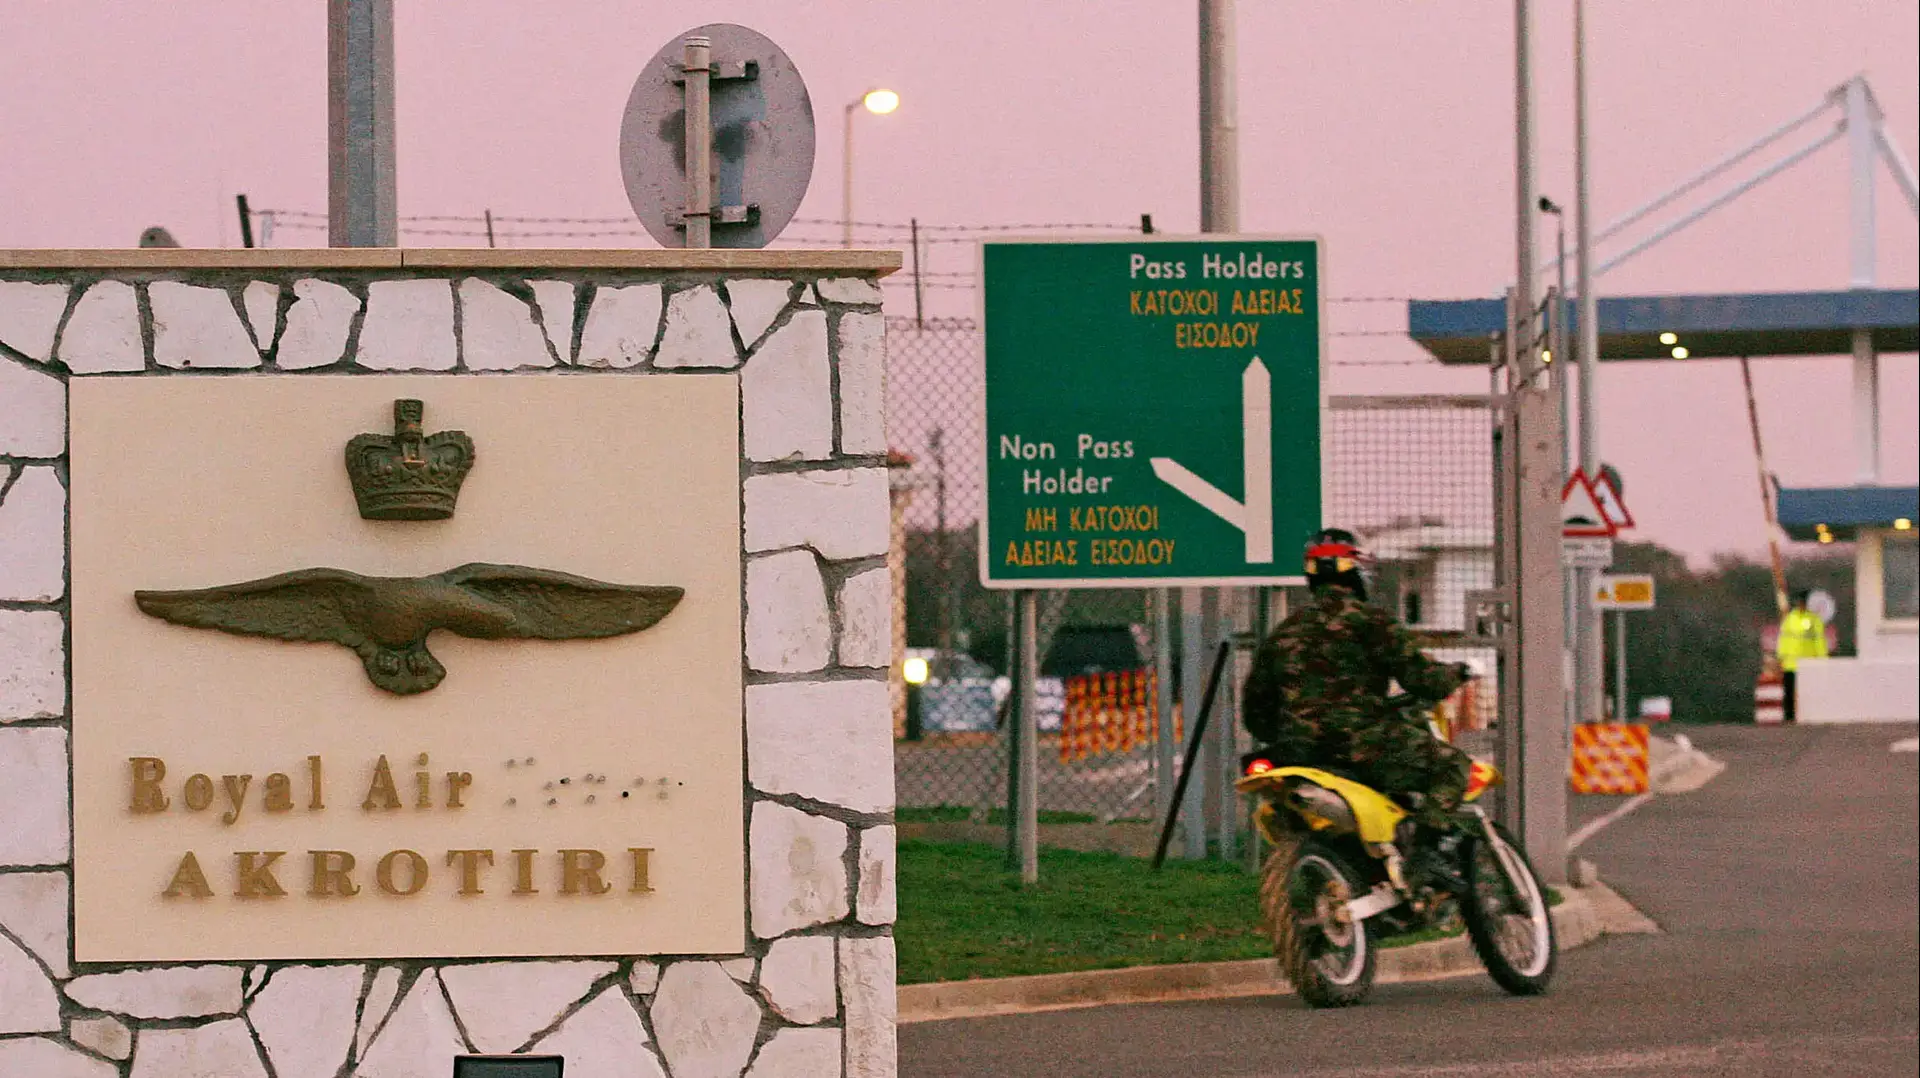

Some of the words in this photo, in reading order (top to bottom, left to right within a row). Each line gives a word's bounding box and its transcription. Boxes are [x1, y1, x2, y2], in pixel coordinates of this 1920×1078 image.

[1130, 253, 1187, 279] Pass
[1202, 251, 1304, 279] Holders
[1130, 289, 1218, 316] ΚΑΤΟΧΟΙ
[1231, 288, 1304, 315] ΑΔΕΙΑΣ
[1175, 321, 1260, 349] ΕΙΣΟΔΟΥ
[999, 434, 1056, 460] Non
[1077, 433, 1135, 459] Pass
[1023, 467, 1113, 495] Holder
[1025, 507, 1057, 532] ΜΗ
[1070, 504, 1159, 532] ΚΑΤΟΧΟΙ
[1005, 539, 1078, 567] ΑΔΕΙΑΣ
[1091, 538, 1175, 566] ΕΙΣΟΔΟΥ
[127, 755, 326, 826] Royal
[361, 752, 473, 811] Air
[161, 847, 656, 898] AKROTIRI
